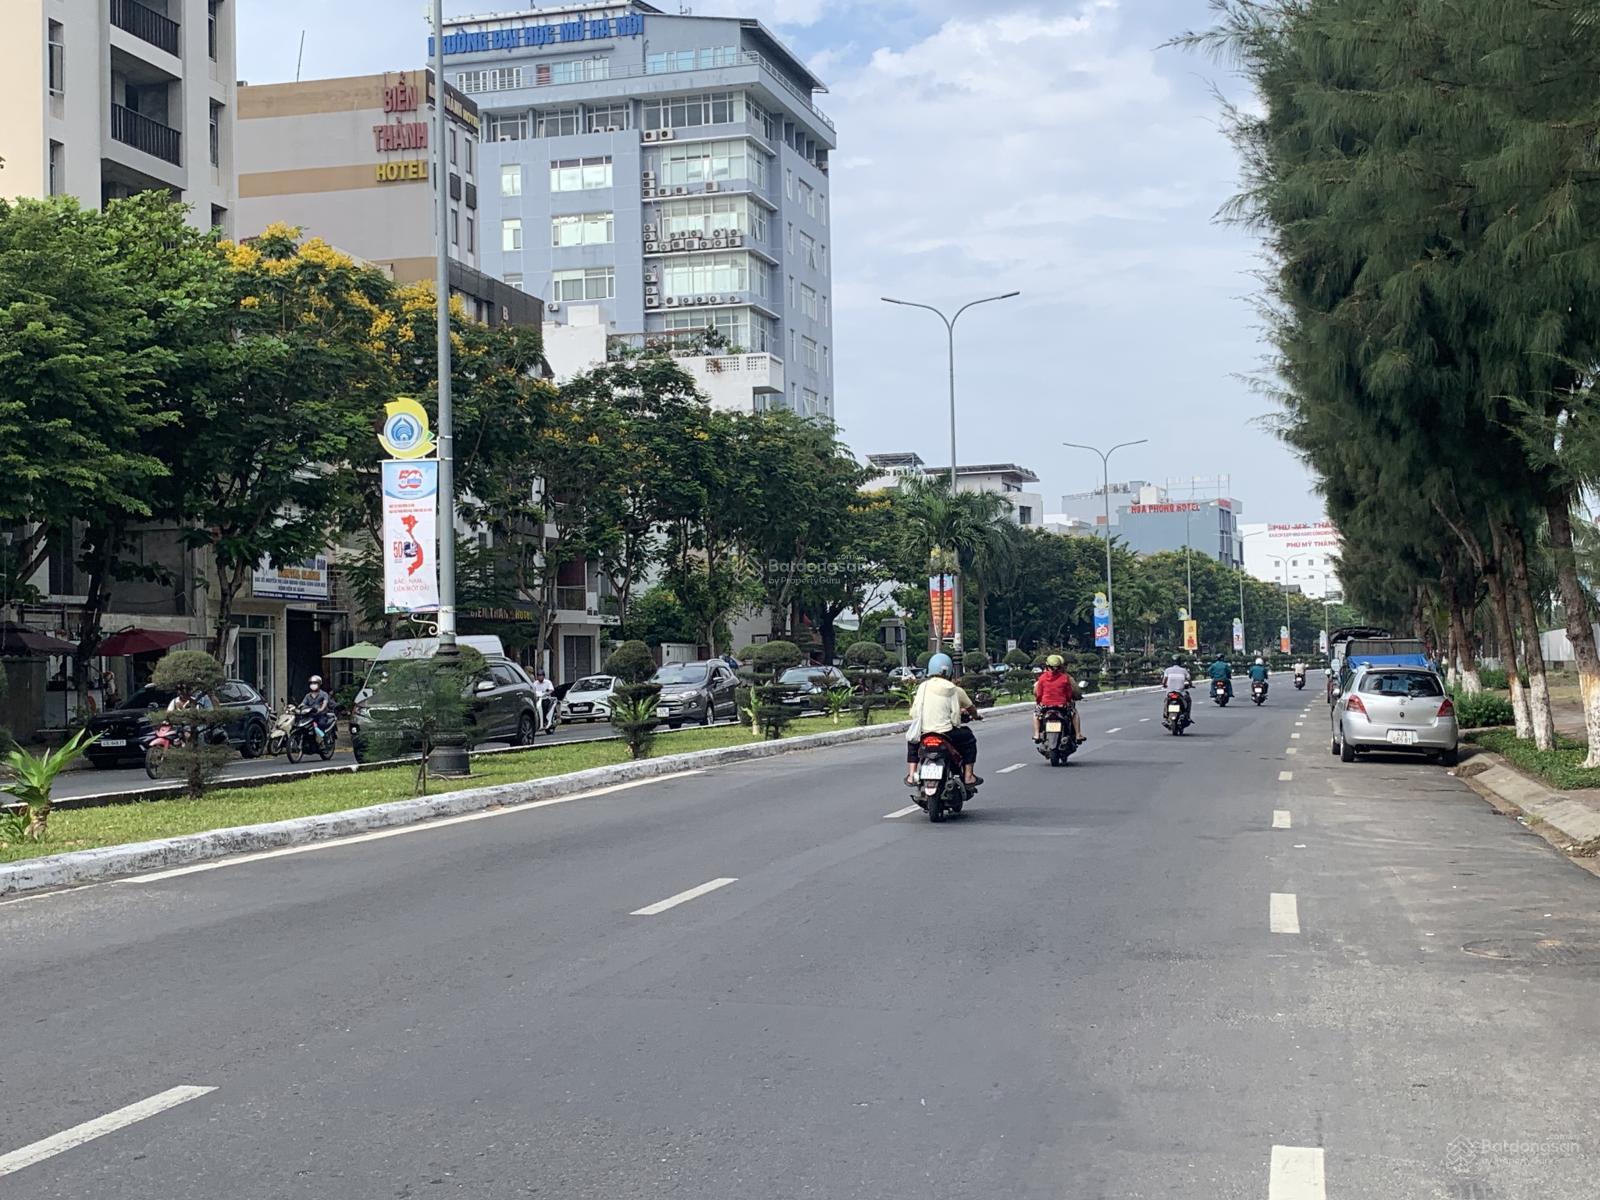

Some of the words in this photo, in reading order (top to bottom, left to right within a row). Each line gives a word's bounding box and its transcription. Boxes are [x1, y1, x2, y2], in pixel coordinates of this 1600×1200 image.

[383, 71, 418, 113] BIỂN
[373, 117, 428, 152] THÀNH
[376, 160, 429, 182] HOTEL
